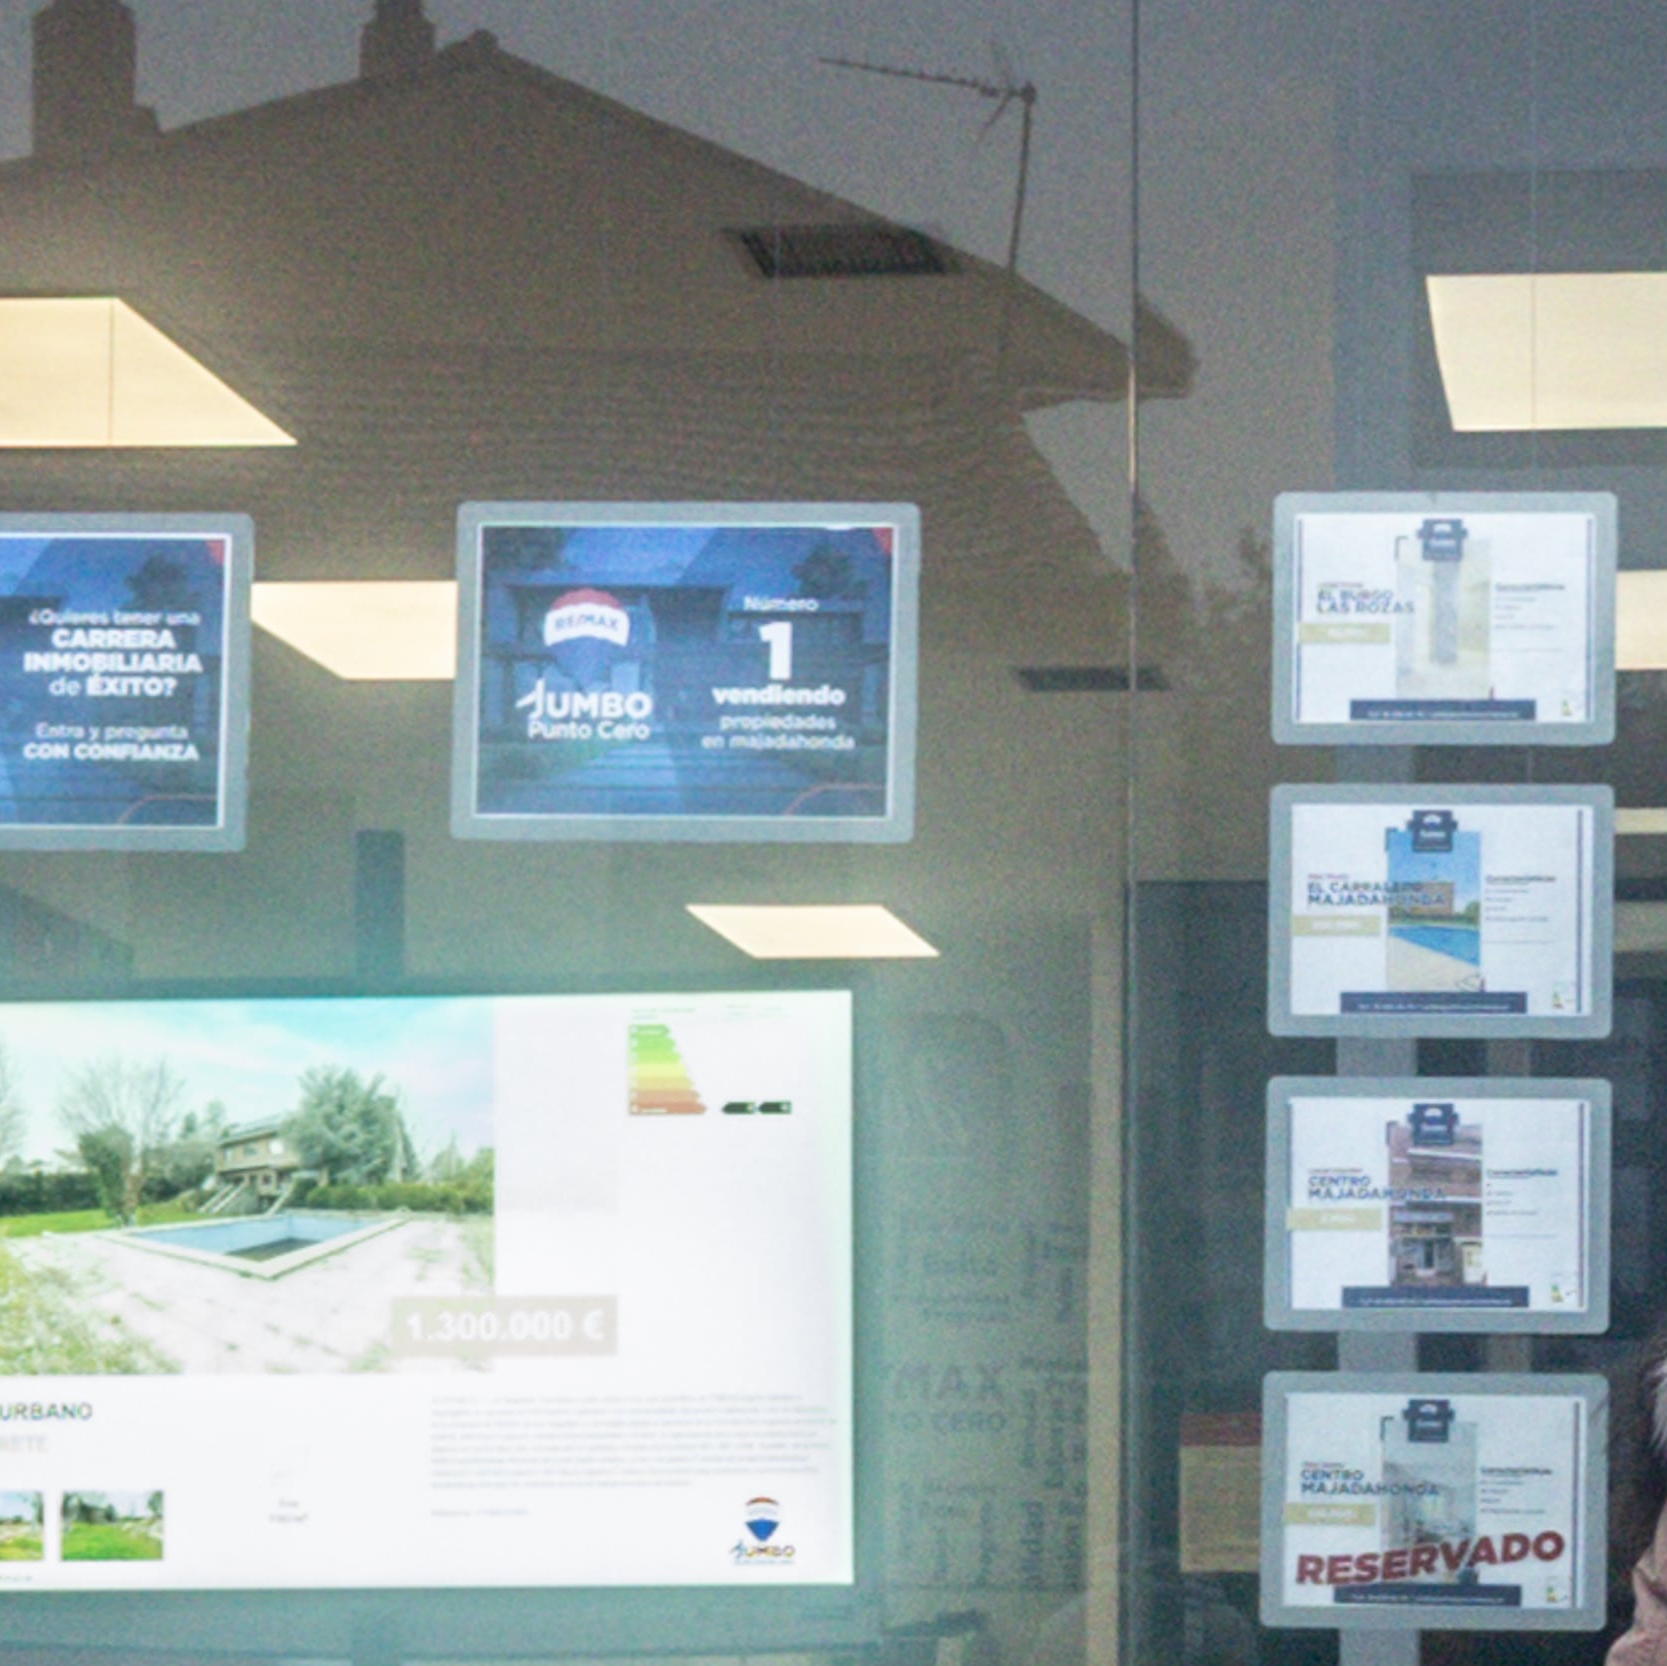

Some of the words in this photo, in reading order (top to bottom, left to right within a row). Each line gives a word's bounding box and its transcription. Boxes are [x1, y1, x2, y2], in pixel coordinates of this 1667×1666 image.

[744, 595, 818, 613] Número
[1317, 602, 1350, 614] LAS
[1356, 602, 1415, 614] ROZAS
[28, 609, 108, 628] ¿Quieres
[112, 609, 162, 625] tener
[165, 612, 201, 625] una
[554, 612, 620, 632] RE/MAX
[51, 630, 177, 649] CARRERA
[759, 622, 793, 680] 1
[23, 652, 203, 673] INMOBILIARIA
[48, 679, 82, 697] de
[86, 673, 178, 697] ÉXITO?
[516, 678, 653, 720] JUMBO
[712, 684, 846, 706] vendiendo
[528, 721, 593, 740] Punto
[597, 721, 650, 740] Cero
[721, 713, 837, 734] propiedades
[35, 723, 84, 740] Entra
[88, 726, 100, 744] y
[105, 724, 189, 744] pregunta
[701, 735, 725, 750] en
[730, 733, 855, 752] majadahonda
[23, 742, 70, 761] CON
[74, 742, 199, 762] CONFIANZA
[1308, 894, 1447, 906] MAJADAHONDA
[1308, 1176, 1371, 1188] CENTRO
[1308, 1188, 1447, 1200] MAJADAHONDA
[406, 1310, 572, 1343] 1.300.000
[583, 1309, 604, 1341] €
[1301, 1470, 1364, 1481] CENTRO
[1301, 1483, 1439, 1495] MAJADAHONDA
[1296, 1530, 1565, 1585] RESERVADO
